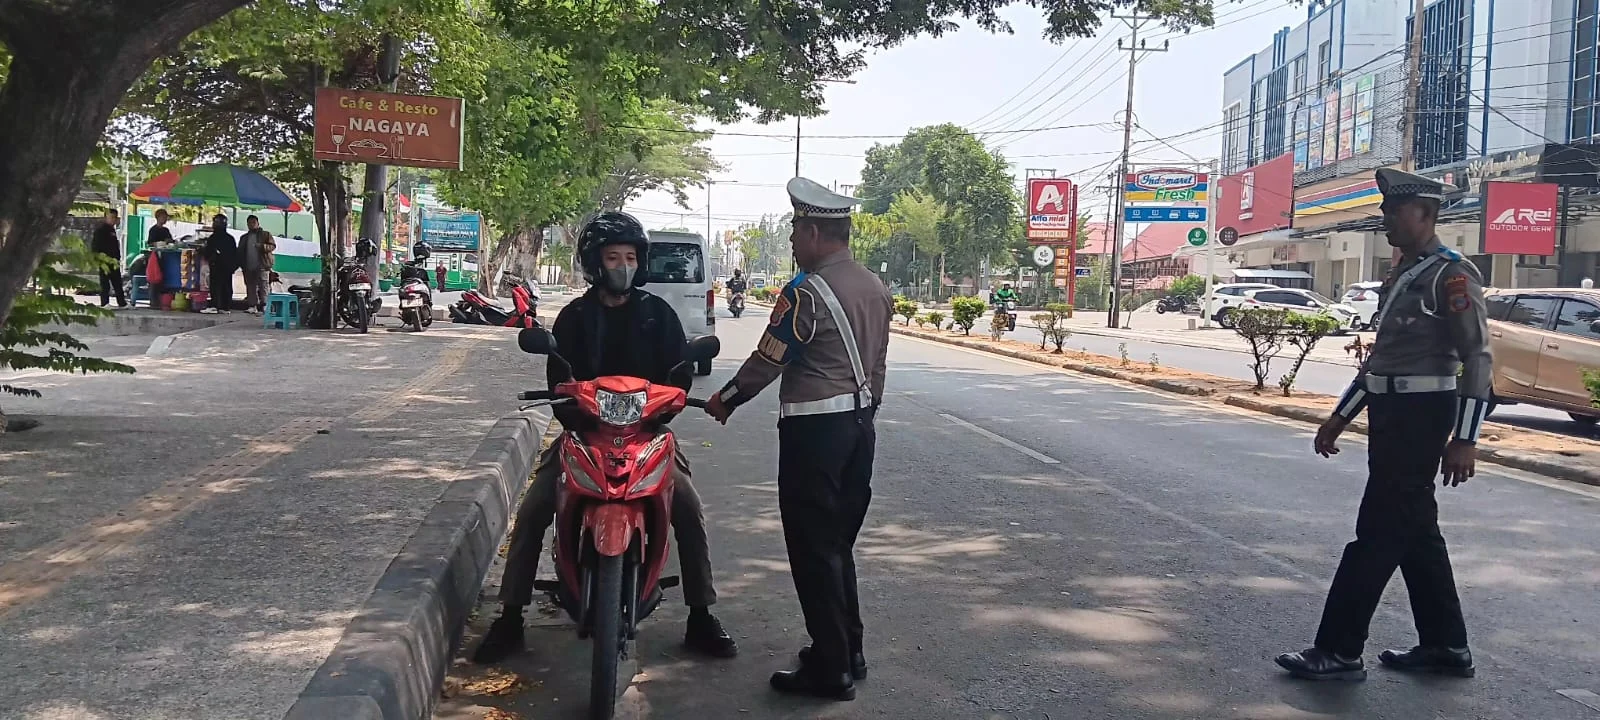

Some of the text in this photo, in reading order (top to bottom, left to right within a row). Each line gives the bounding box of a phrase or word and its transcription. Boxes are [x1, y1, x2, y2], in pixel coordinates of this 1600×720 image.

[340, 96, 439, 116] Cafe & Resto
[349, 117, 430, 137] NAGAYA
[1140, 174, 1193, 186] Indomaret
[1154, 187, 1195, 202] Fresh
[1518, 207, 1552, 225] Rei
[1489, 223, 1528, 232] OUTDOOR
